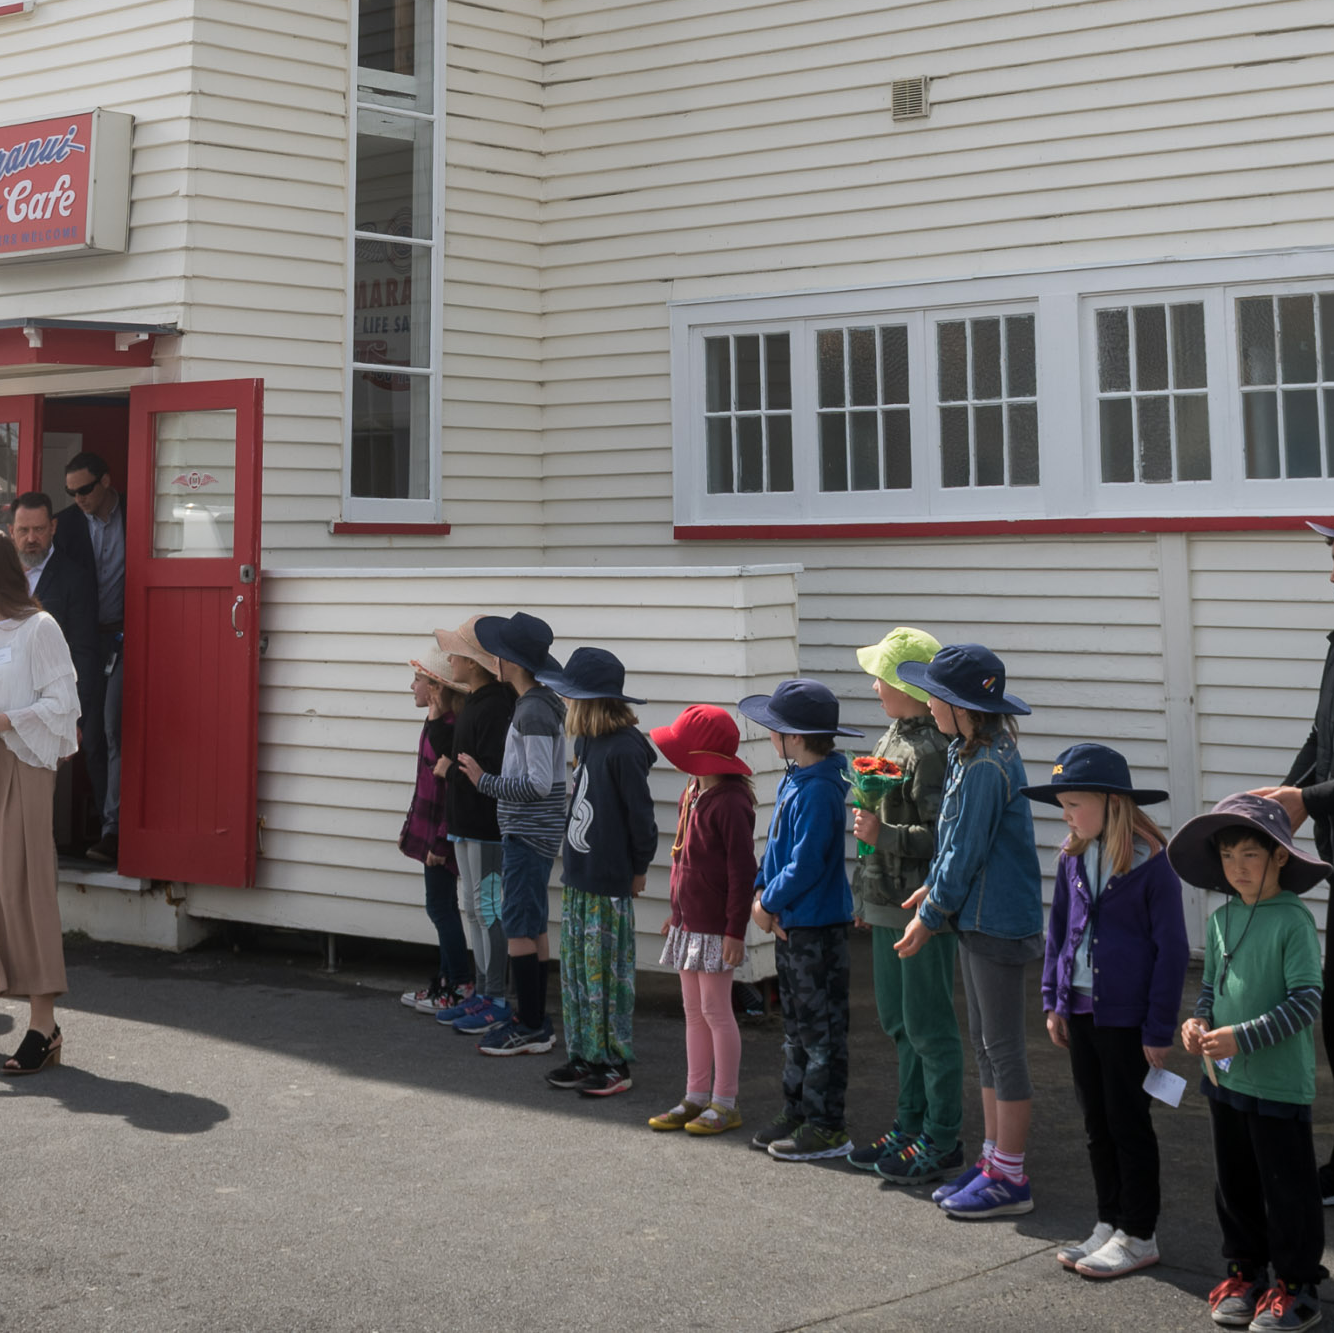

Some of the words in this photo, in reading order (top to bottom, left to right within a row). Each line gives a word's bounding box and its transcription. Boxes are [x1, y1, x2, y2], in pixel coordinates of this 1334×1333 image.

[4, 174, 76, 223] Cafe
[21, 225, 78, 243] WELCOME
[363, 315, 389, 334] LIFE
